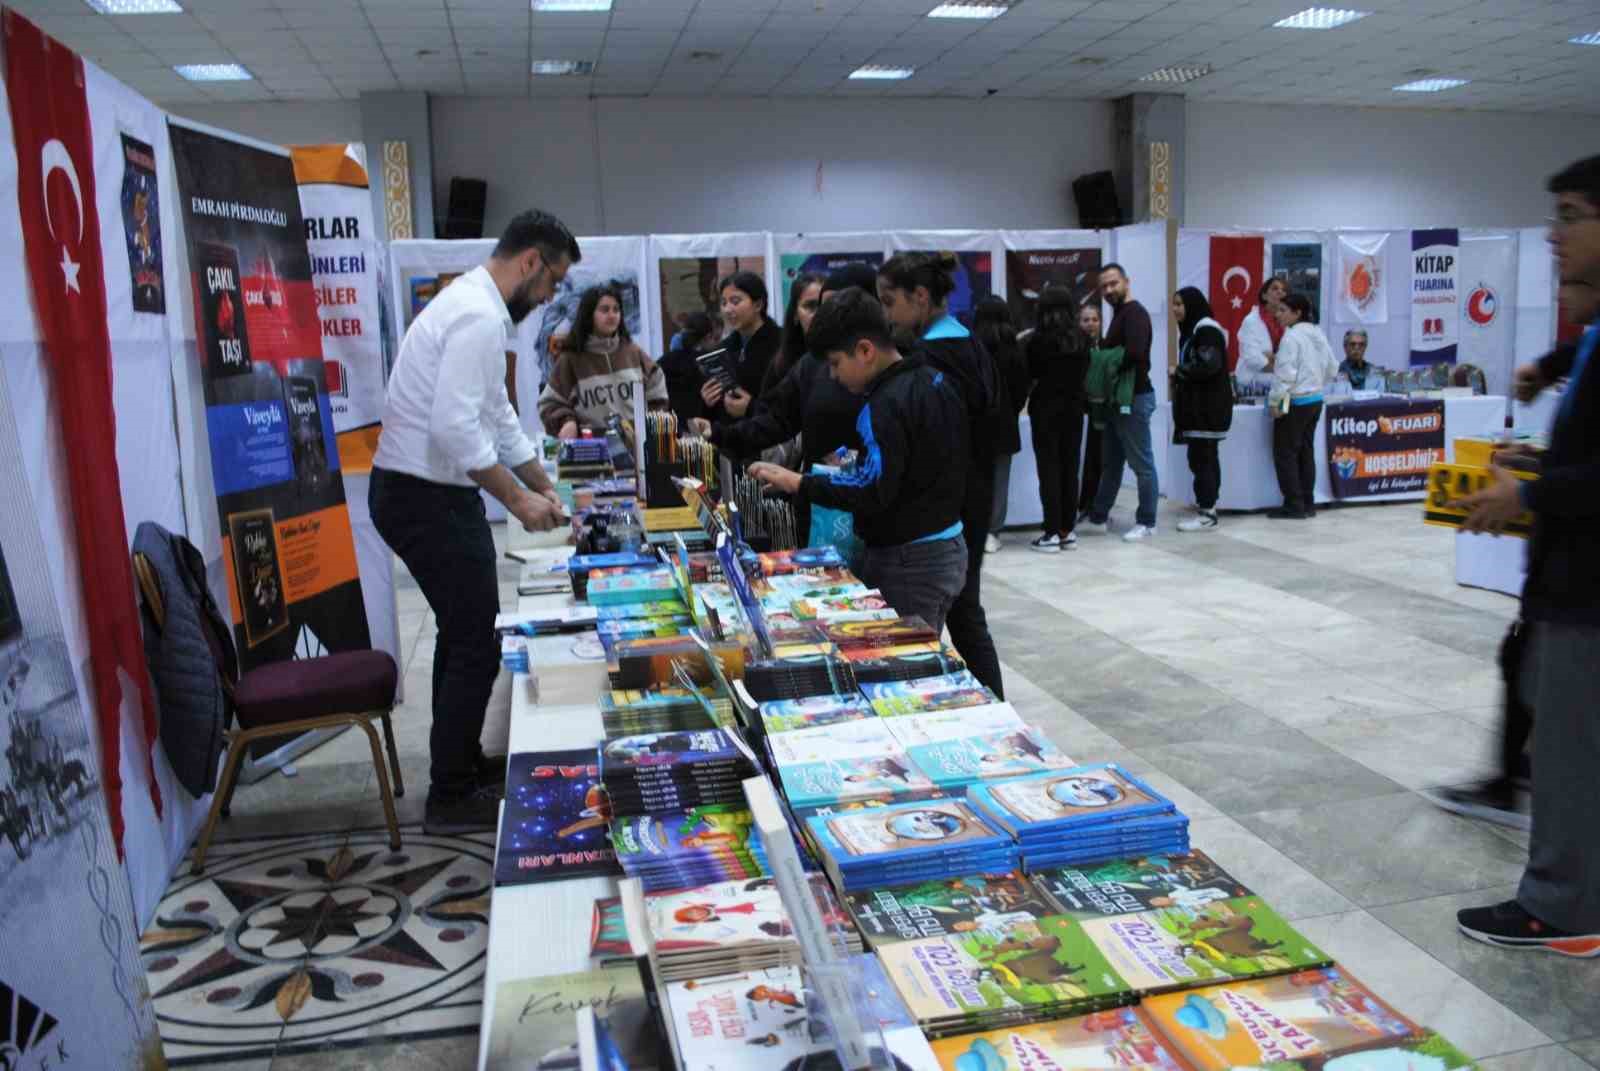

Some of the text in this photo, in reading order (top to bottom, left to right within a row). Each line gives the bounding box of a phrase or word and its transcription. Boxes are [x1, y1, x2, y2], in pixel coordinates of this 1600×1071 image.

[192, 196, 229, 217] EMRAH
[1415, 252, 1454, 274] KİTAP
[207, 266, 236, 295] ÇAKIL
[1414, 278, 1454, 291] FUARINA
[218, 339, 242, 366] TAŞI
[1331, 415, 1437, 437] Kitap FUARI
